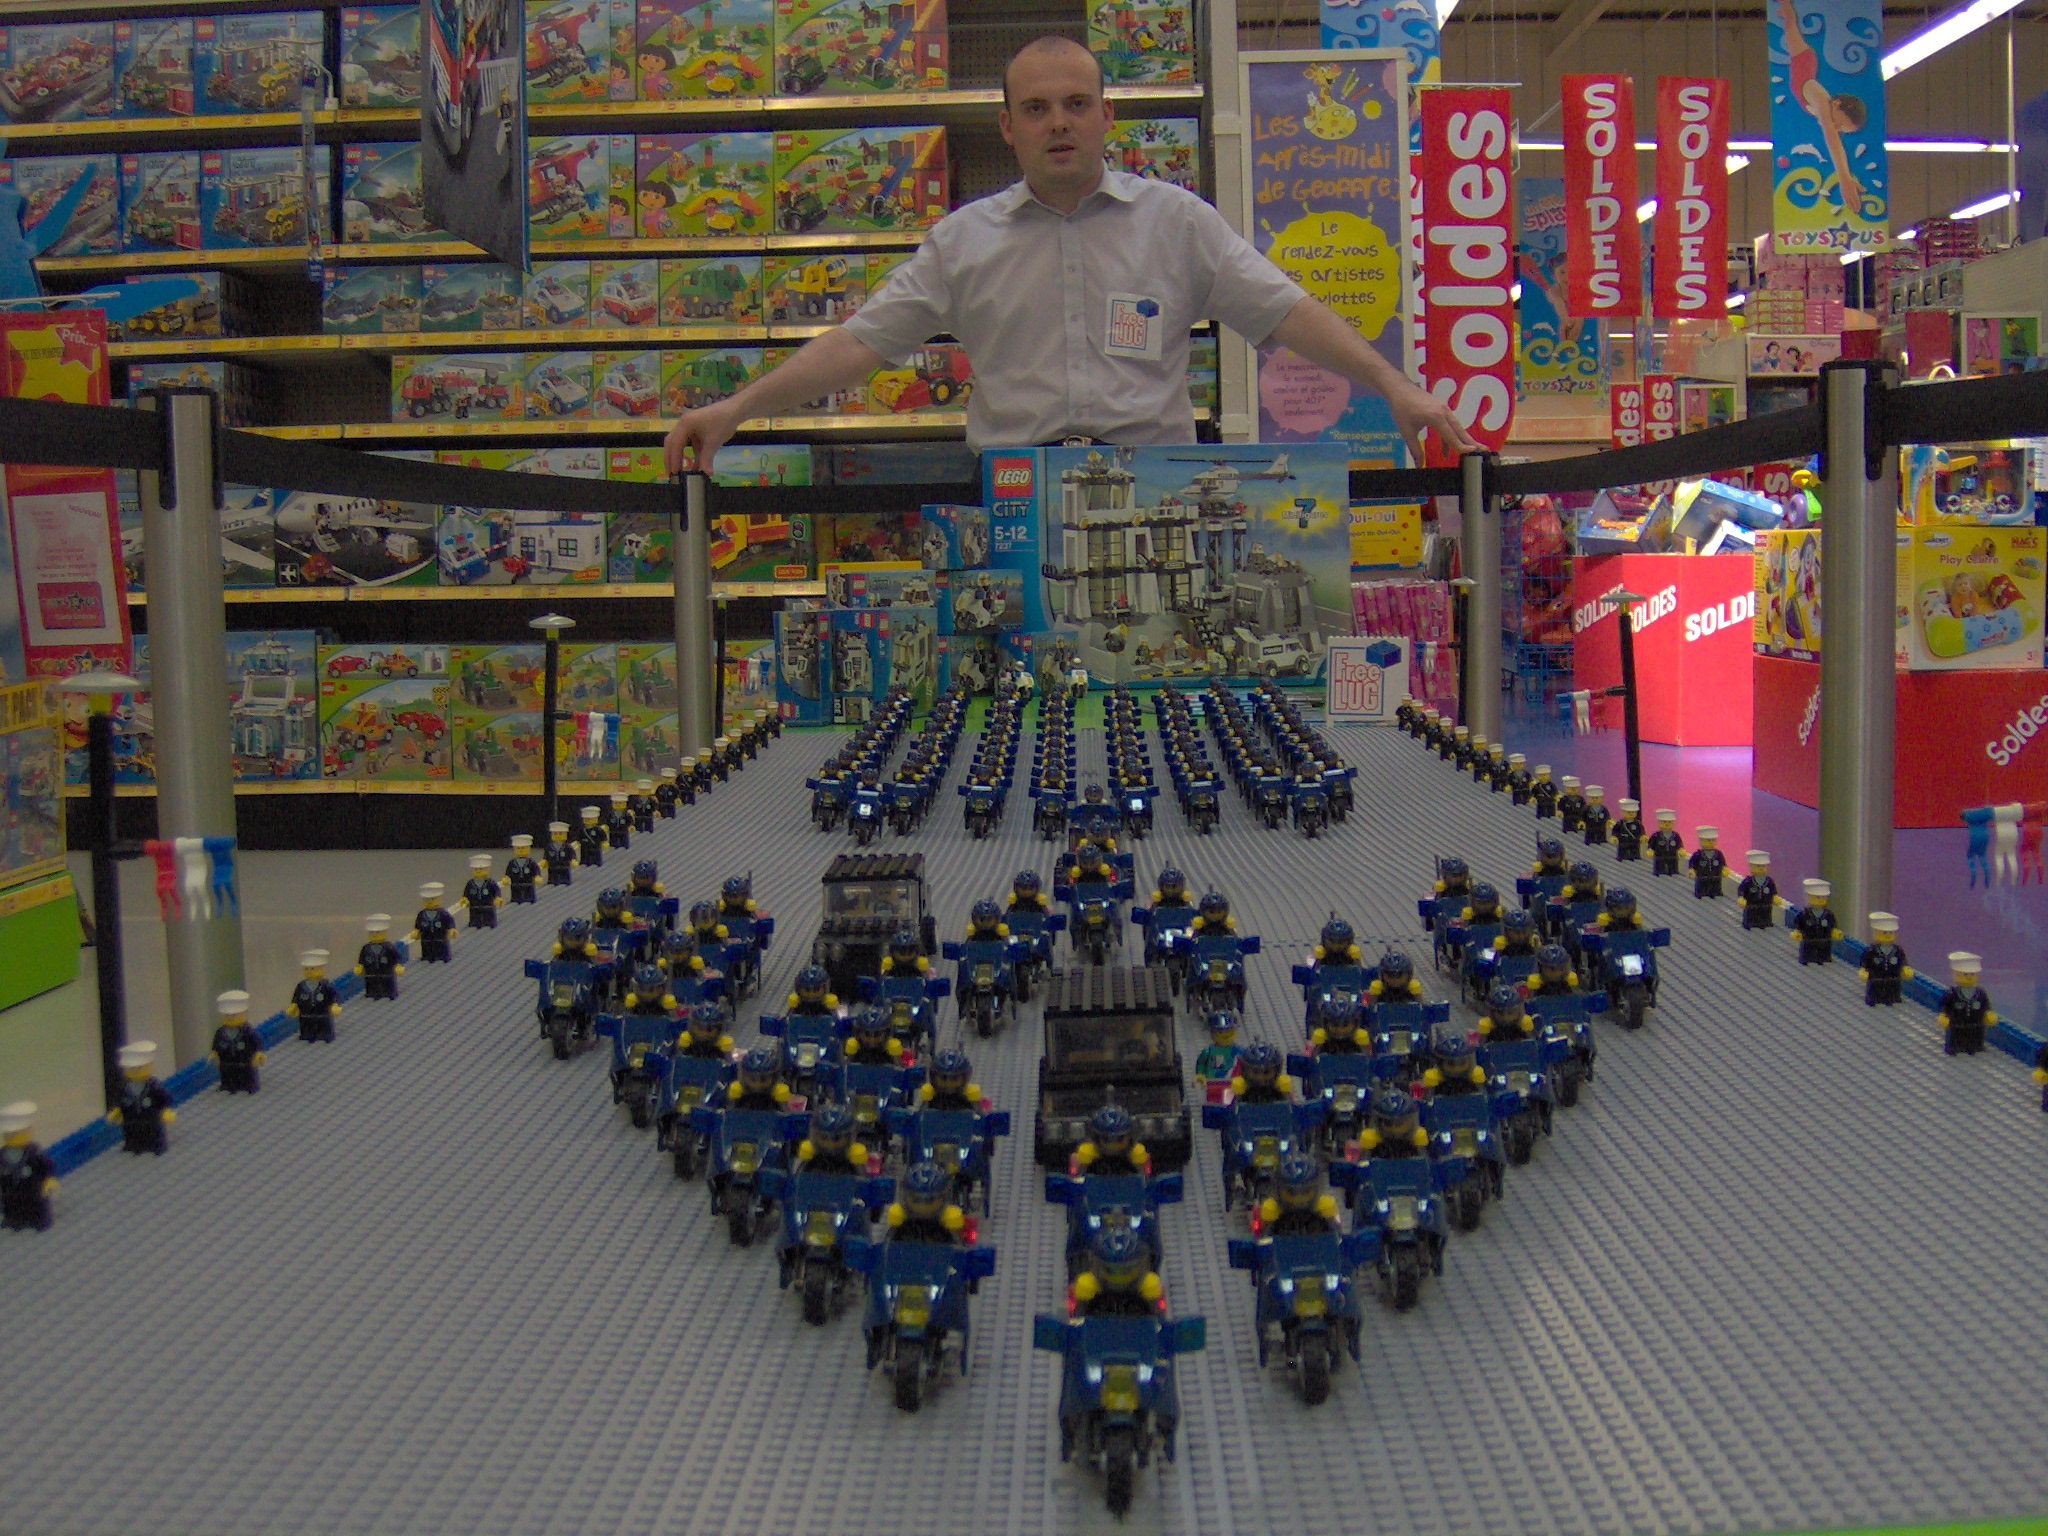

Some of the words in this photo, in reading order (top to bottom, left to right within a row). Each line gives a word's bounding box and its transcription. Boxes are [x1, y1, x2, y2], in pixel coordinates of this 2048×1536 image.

[1255, 115, 1299, 140] Les
[1257, 177, 1286, 204] de
[1583, 82, 1621, 309] SOLDES
[1674, 86, 1711, 310] SOLDES
[1321, 222, 1338, 236] Le
[1778, 231, 1830, 246] TOYS
[1859, 230, 1885, 245] US
[1281, 245, 1379, 260] rendez-vous
[1311, 268, 1386, 283] artistes
[1428, 109, 1510, 432] Soldes
[1114, 303, 1146, 326] Free
[1113, 322, 1145, 346] LUG
[1523, 381, 1559, 391] TOYS
[1579, 381, 1596, 391] US
[995, 468, 1032, 487] LEGO
[995, 526, 1028, 540] 5-12
[1335, 651, 1381, 683] Free
[1333, 679, 1380, 711] LUG
